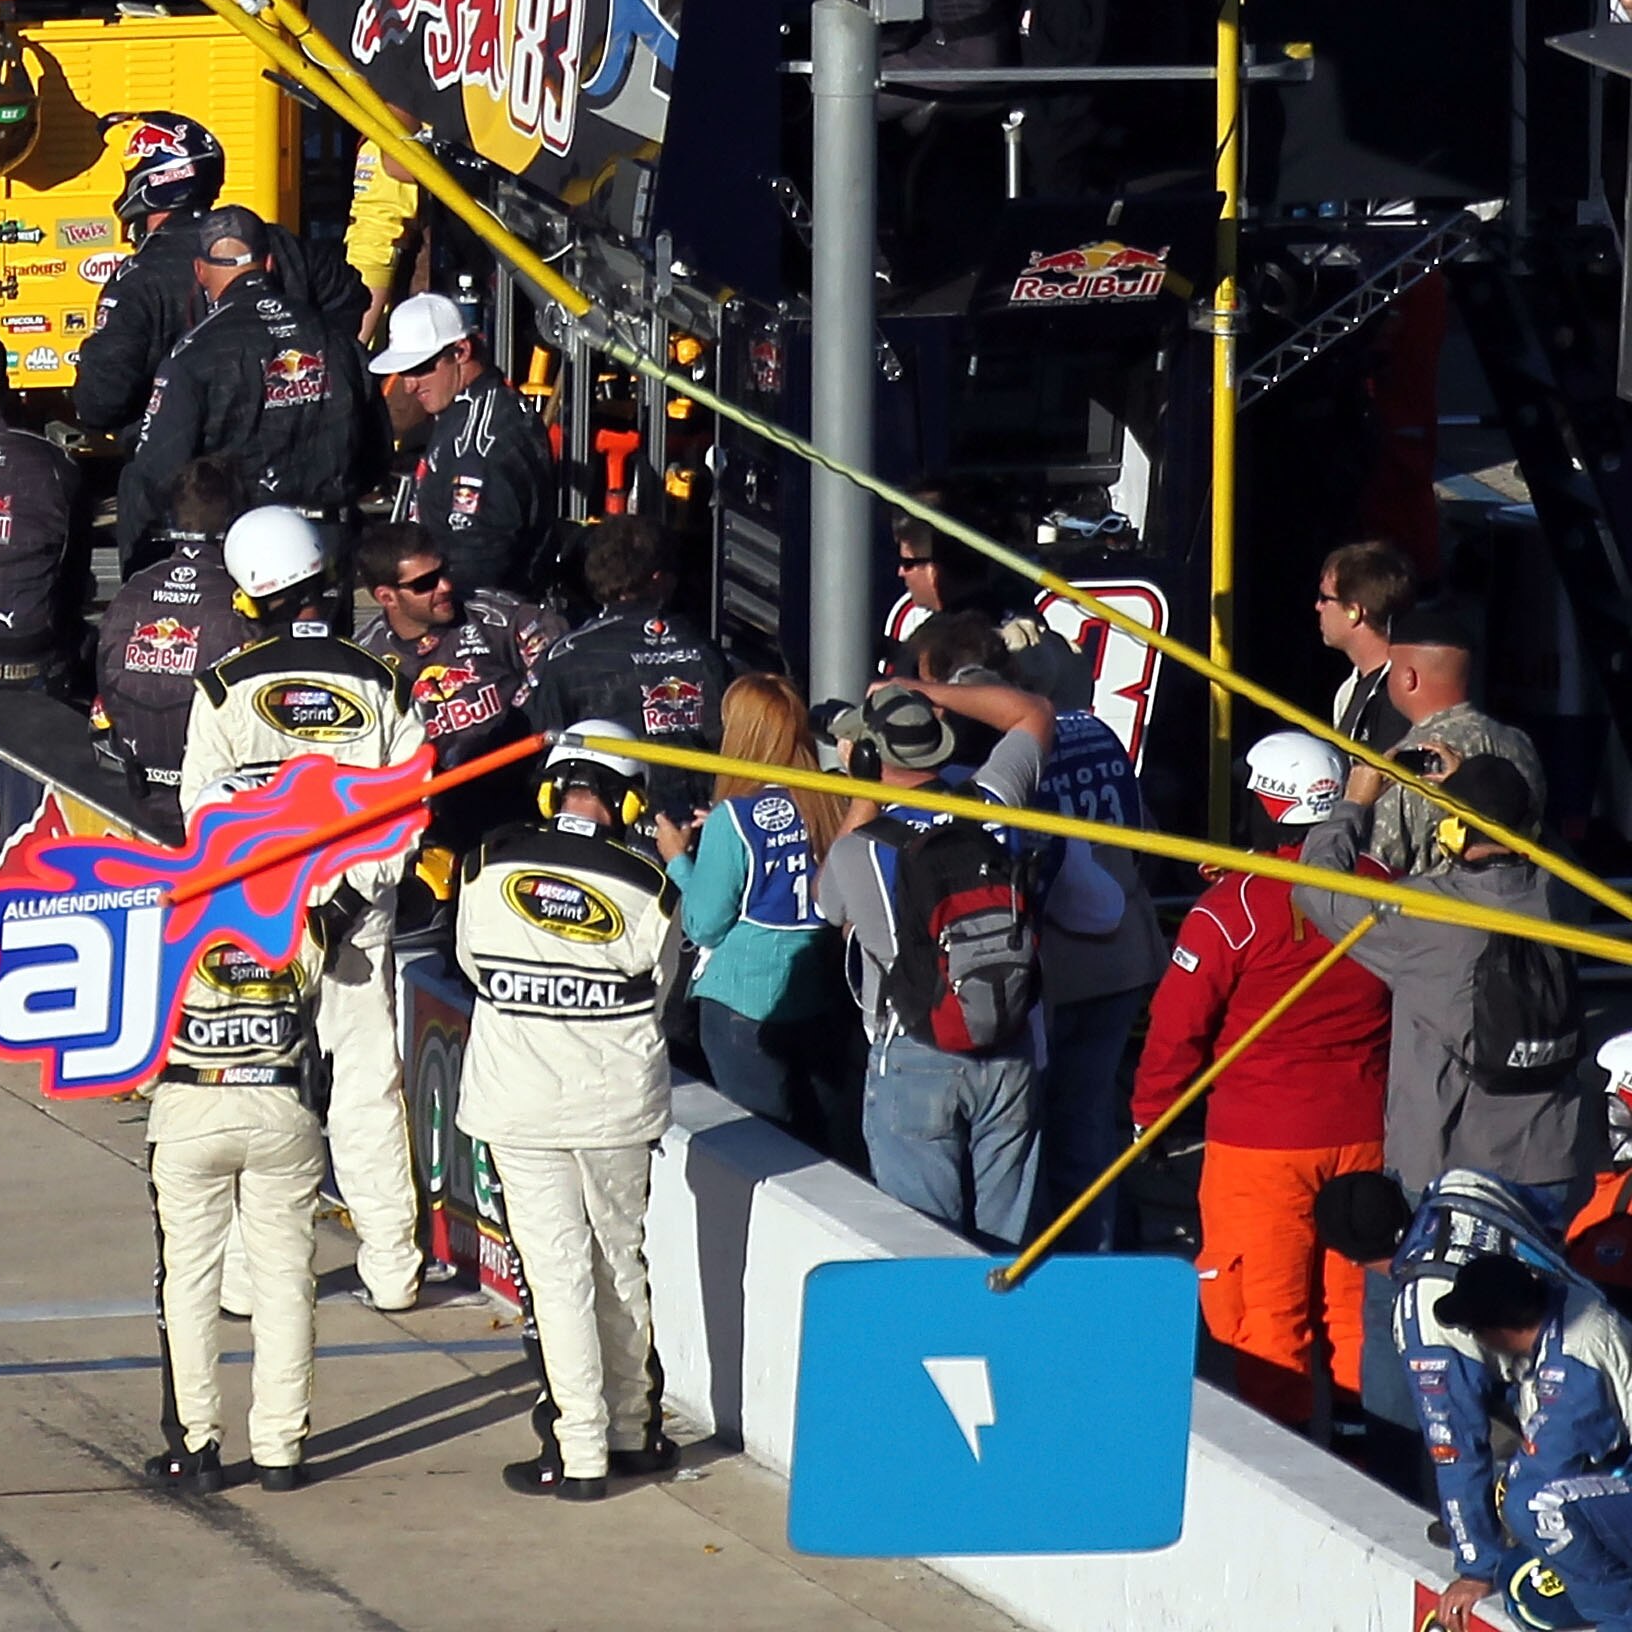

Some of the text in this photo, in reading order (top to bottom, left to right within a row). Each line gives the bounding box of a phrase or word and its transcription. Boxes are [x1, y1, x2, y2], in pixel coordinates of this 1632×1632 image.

[63, 221, 110, 245] Twix
[3, 260, 67, 279] Starburst
[83, 254, 123, 277] Comb
[1011, 271, 1166, 301] Red Bull
[3, 315, 44, 327] LINCOLN
[125, 643, 196, 671] Red Bull
[292, 706, 335, 723] Sprint
[449, 684, 502, 736] Bull
[145, 768, 182, 783] TOYOT
[1255, 774, 1298, 796] TEXAS
[3, 887, 165, 920] ALLMENDINGER
[540, 898, 585, 922] Sprint
[230, 965, 272, 981] Sprint
[488, 972, 625, 1010] OFFICIAL
[187, 1016, 284, 1046] OFFICI
[222, 1067, 276, 1083] NASCAR
[478, 1235, 510, 1280] PARTS
